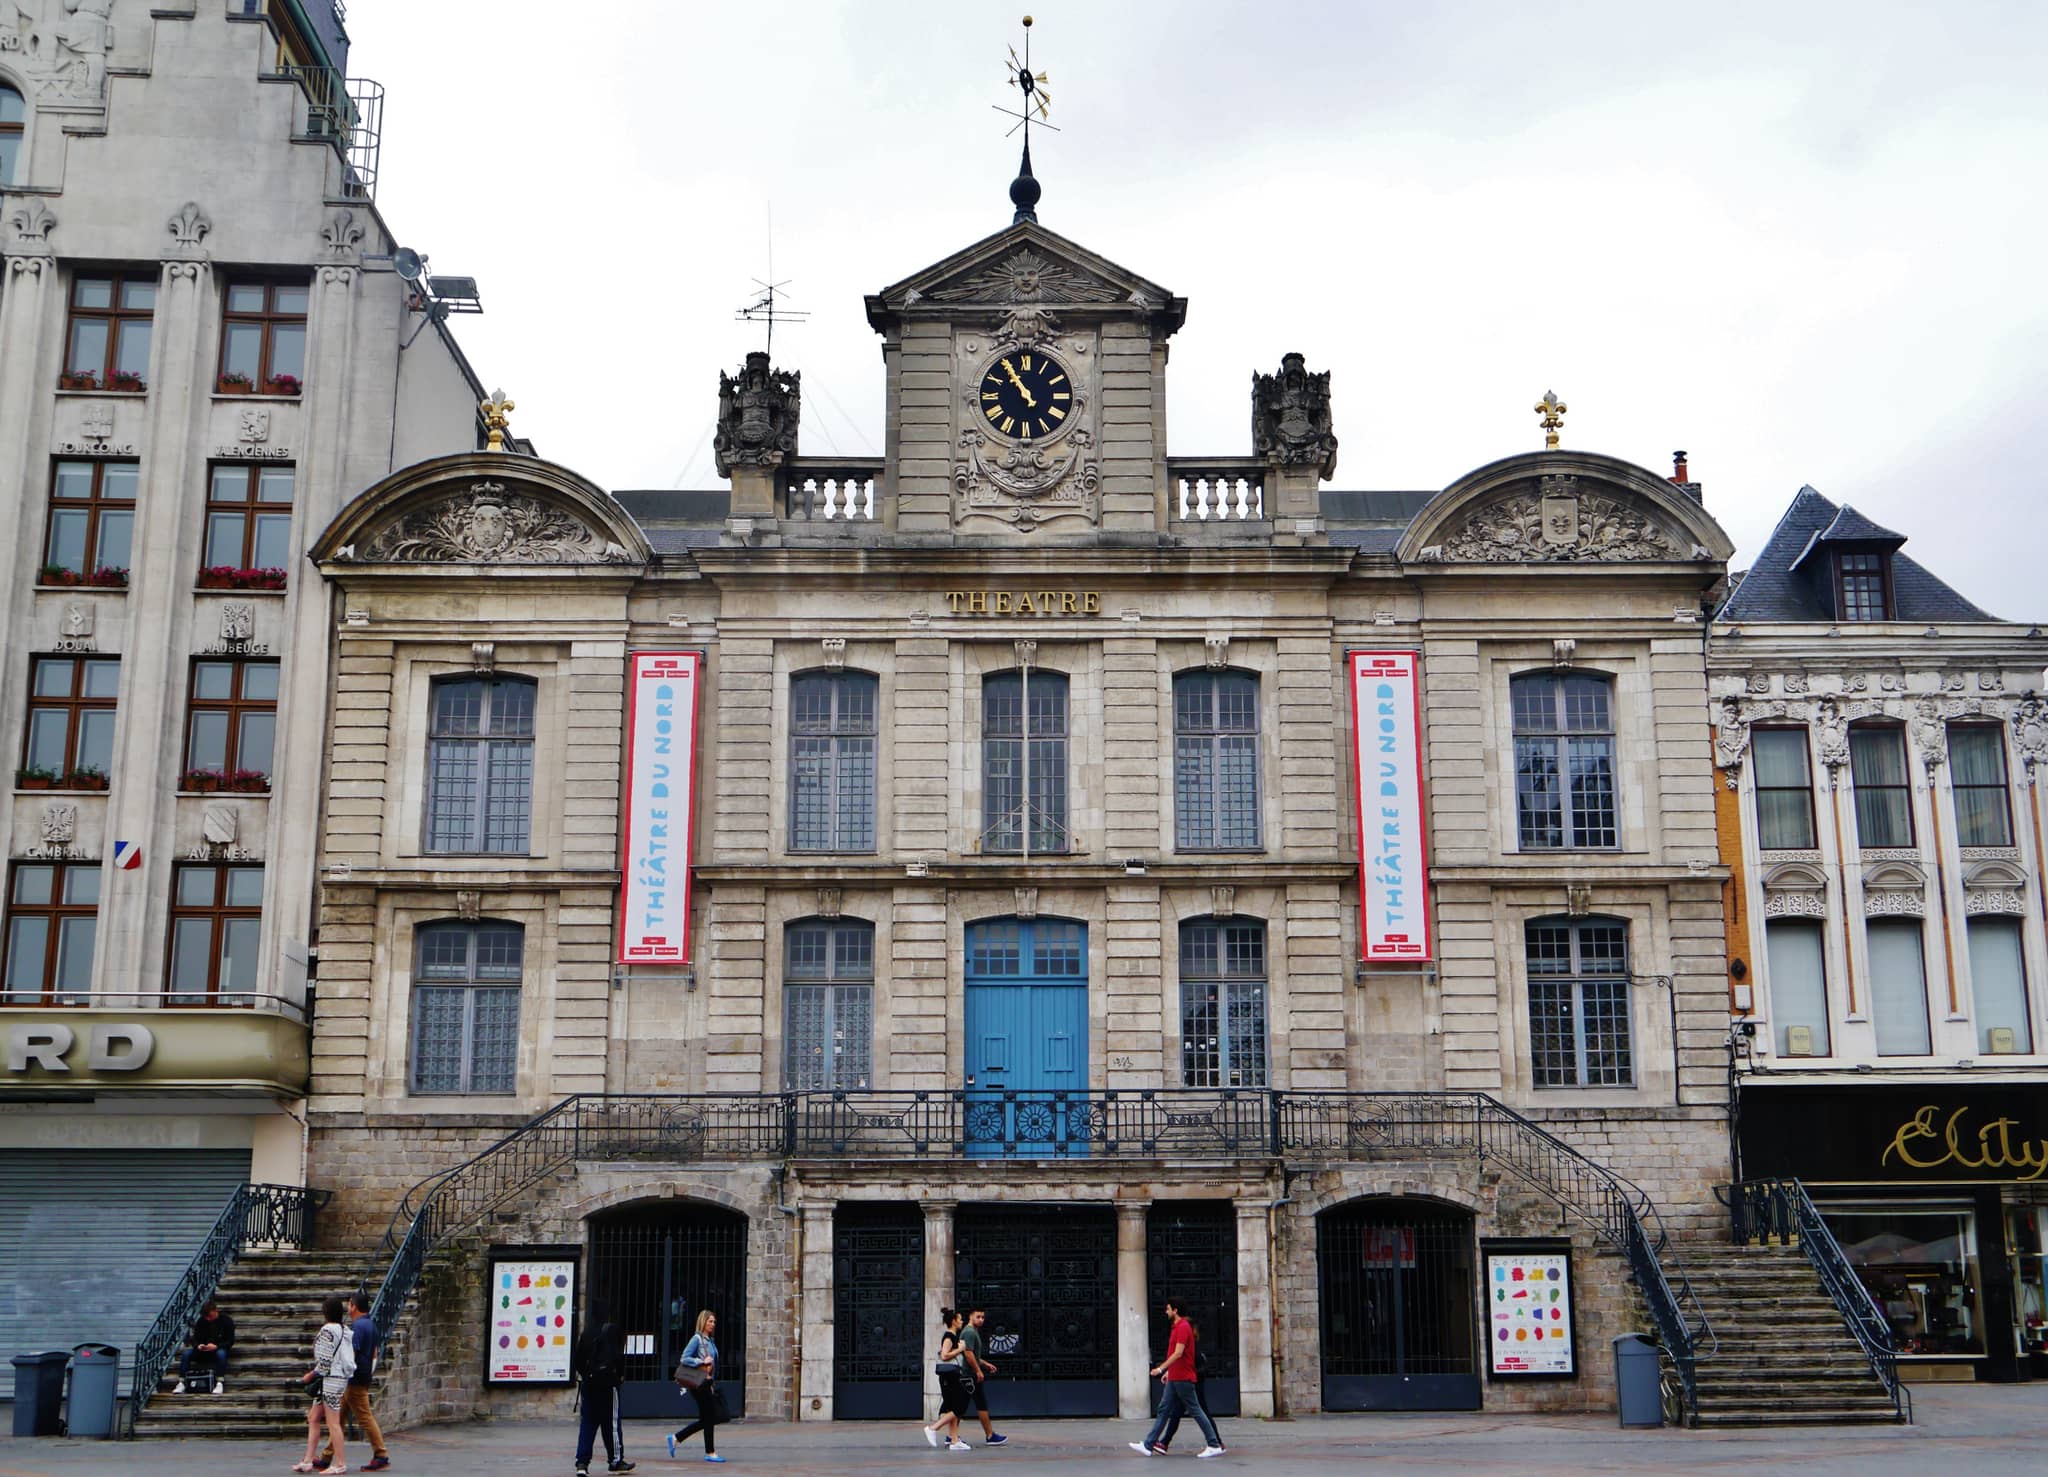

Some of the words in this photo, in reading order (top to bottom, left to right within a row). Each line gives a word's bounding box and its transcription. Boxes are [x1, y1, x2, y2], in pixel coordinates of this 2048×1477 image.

[58, 441, 133, 454] TOURCOING
[215, 446, 288, 457] VALENCIENNES
[945, 591, 1100, 613] THEATRE
[55, 639, 97, 651] DOUAI
[202, 642, 268, 654] MAUBEUGE
[653, 684, 674, 755] NORD
[1376, 683, 1397, 753] NORD
[650, 763, 671, 799] DU
[1380, 762, 1400, 797] DU
[26, 847, 84, 858] CAMBRAI
[639, 809, 668, 928] THÉÂTRE
[1374, 807, 1404, 927] THÉÂTRE
